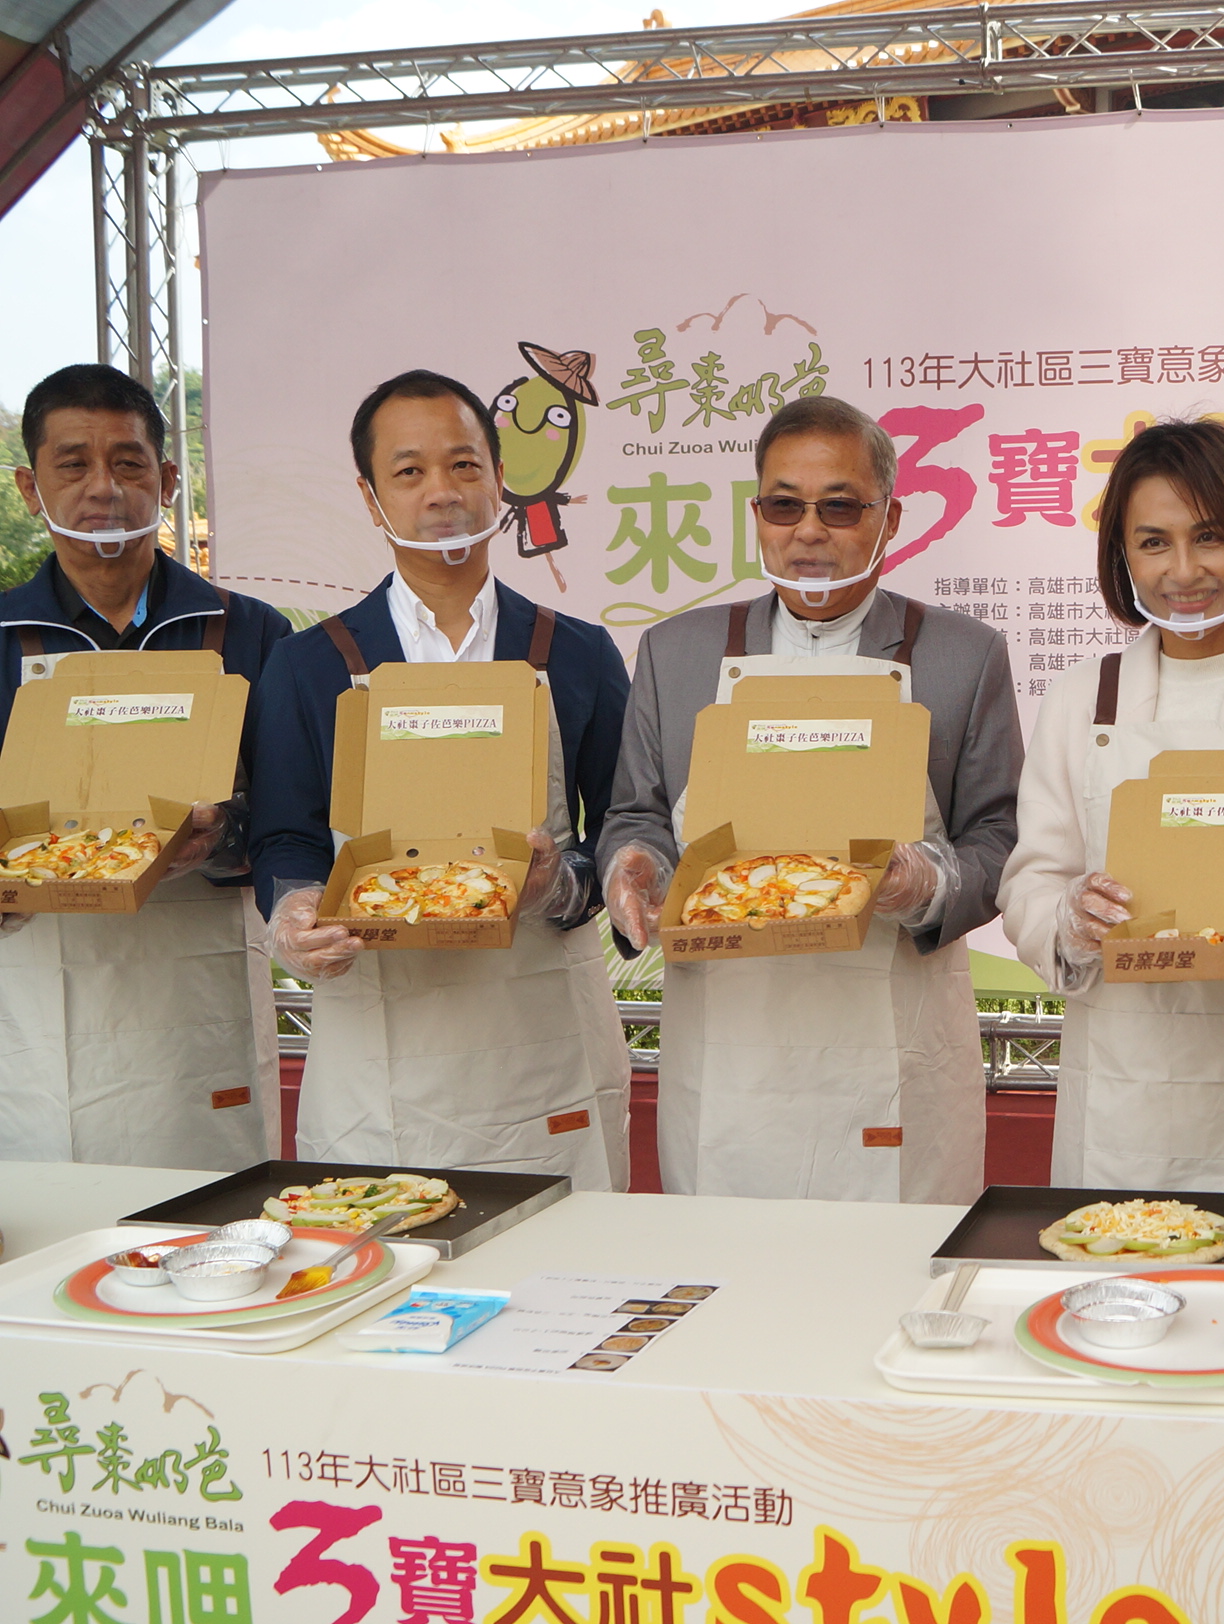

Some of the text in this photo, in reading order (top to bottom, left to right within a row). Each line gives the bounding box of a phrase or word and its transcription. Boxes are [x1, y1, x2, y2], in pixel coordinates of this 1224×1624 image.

[622, 439, 758, 456] Chui Zuoa Wuli
[939, 602, 1112, 621] 辦單位：高雄市大
[672, 934, 743, 953] 奇窯學堂
[1114, 950, 1196, 971] 奇窯學堂
[263, 1448, 793, 1527] 113年大社區三寶意象推廣活動
[37, 1499, 244, 1533] Chui Zuoa Wuliang Bala
